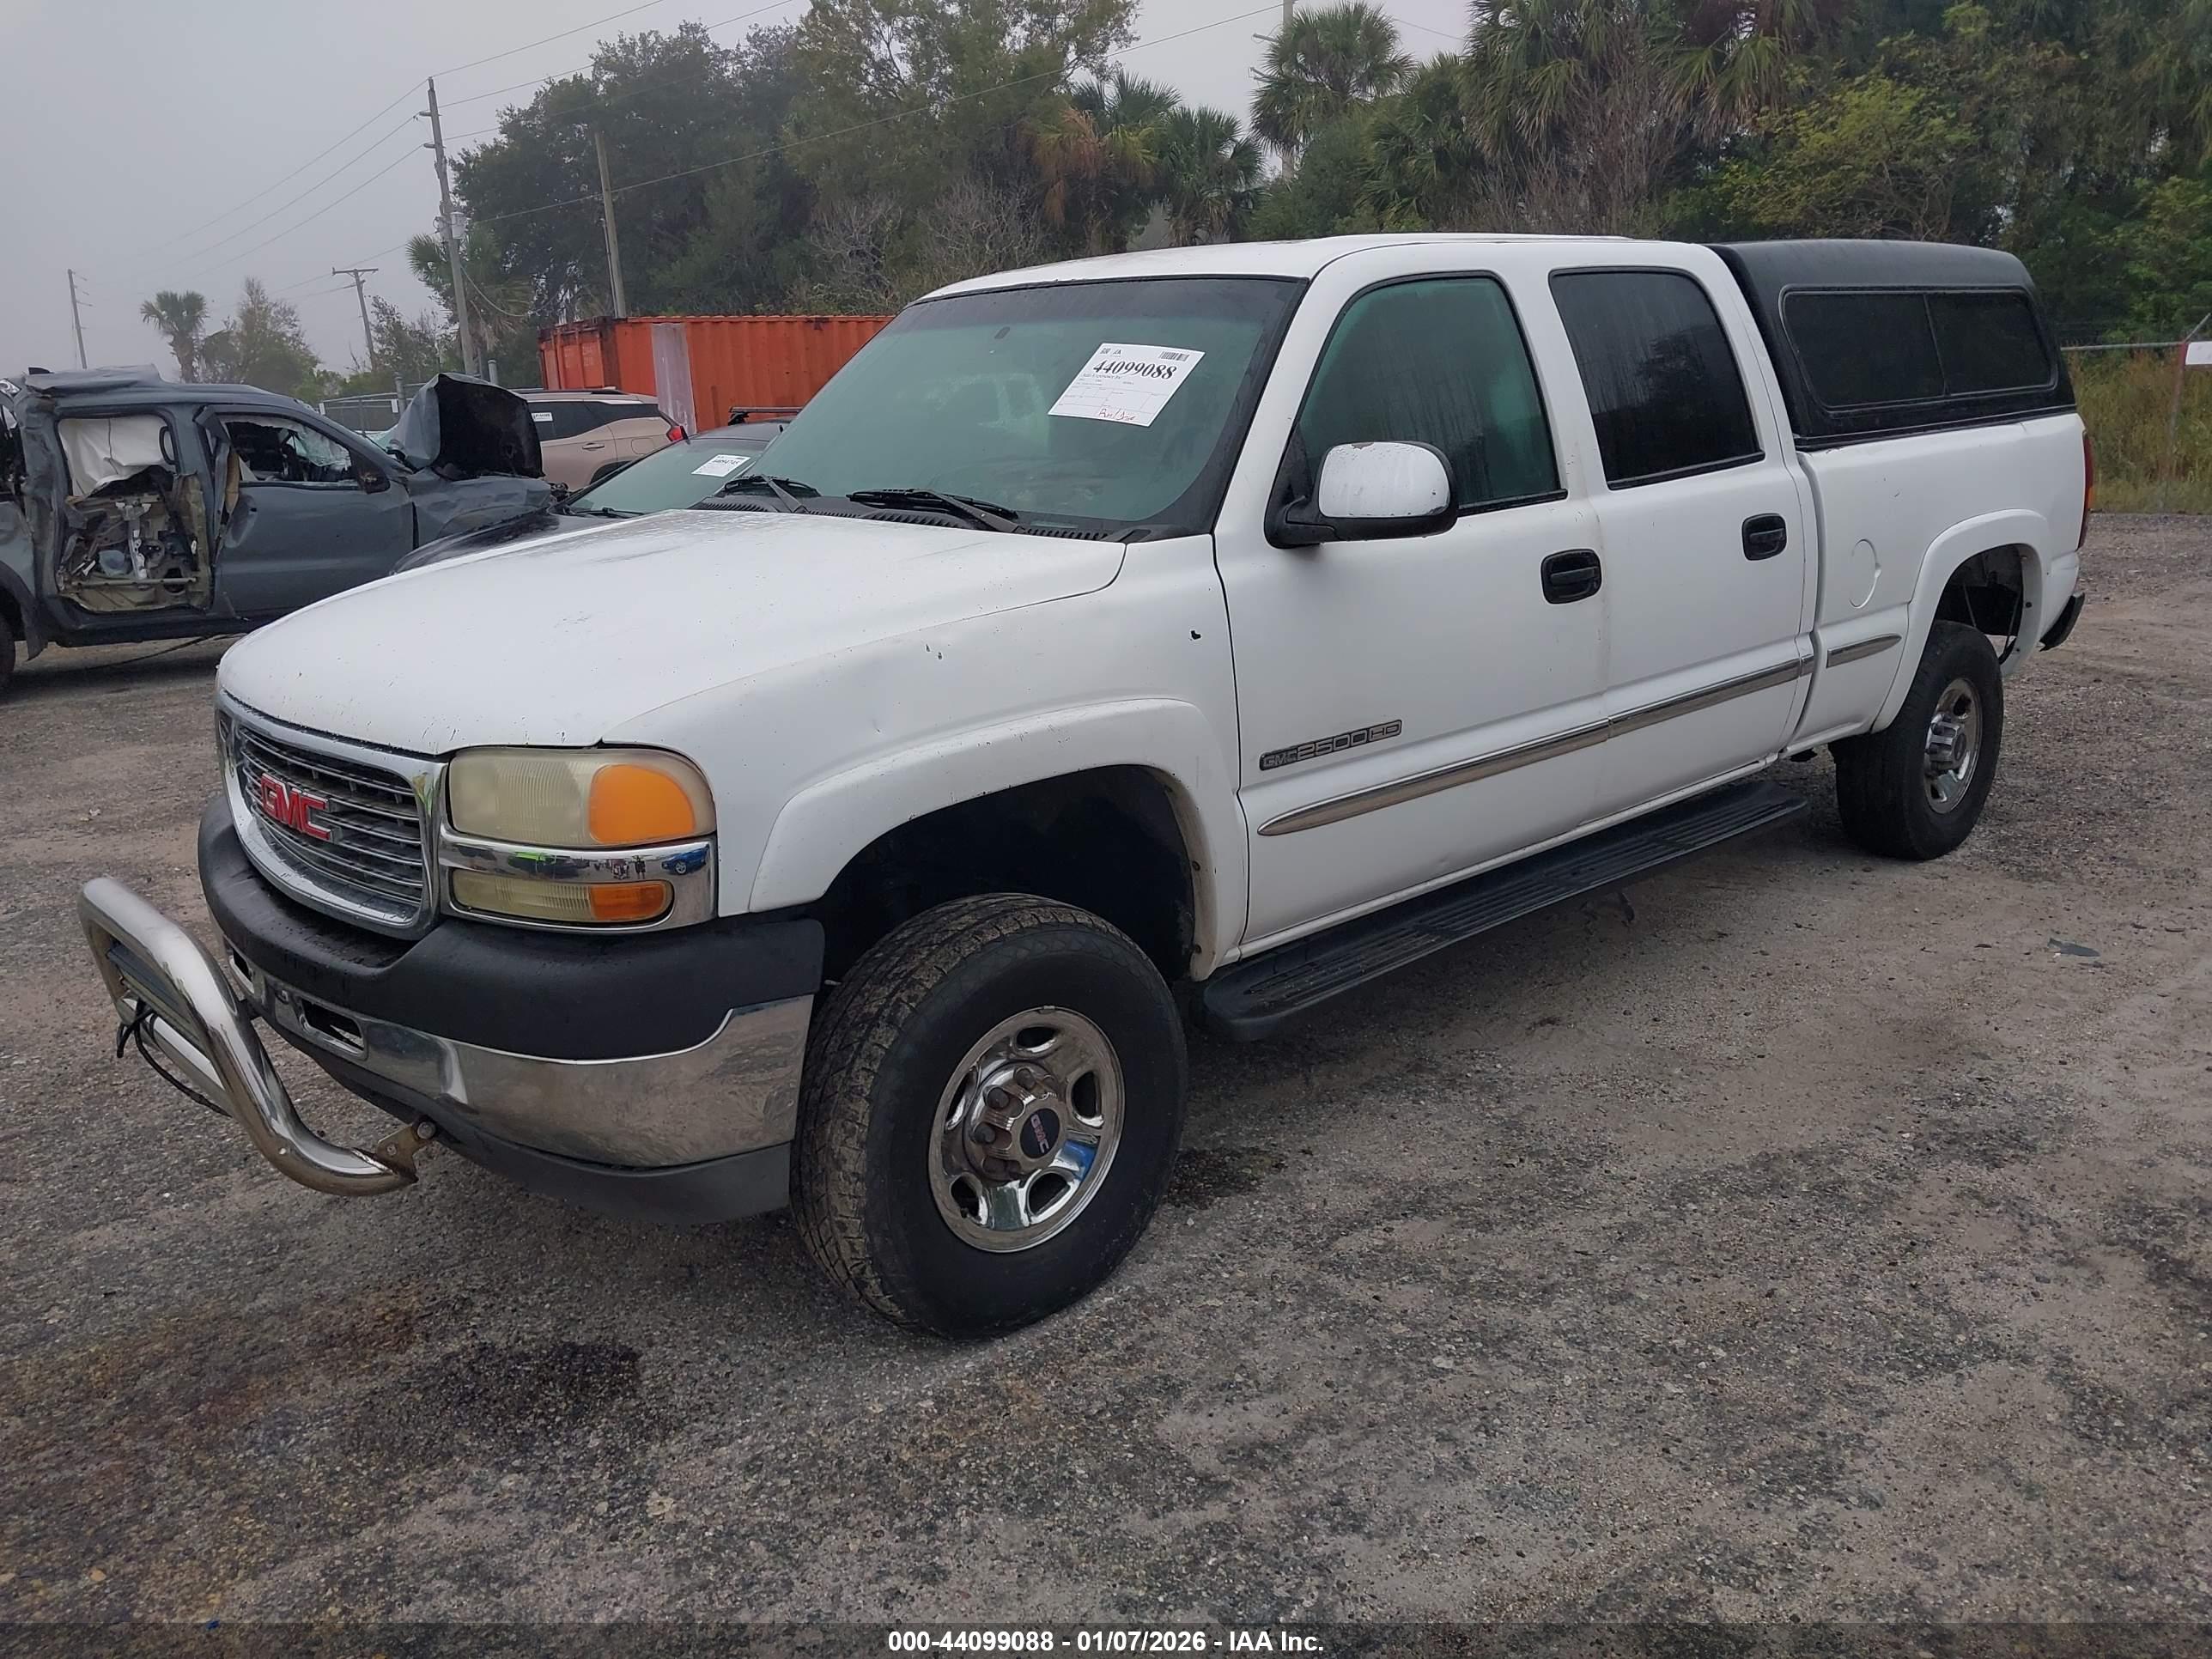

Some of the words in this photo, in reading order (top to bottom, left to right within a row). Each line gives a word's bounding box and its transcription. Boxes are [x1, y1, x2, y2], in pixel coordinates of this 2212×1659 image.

[1093, 359, 1177, 380] 44099088
[260, 773, 332, 843] GMC
[1030, 1114, 1050, 1154] GMC
